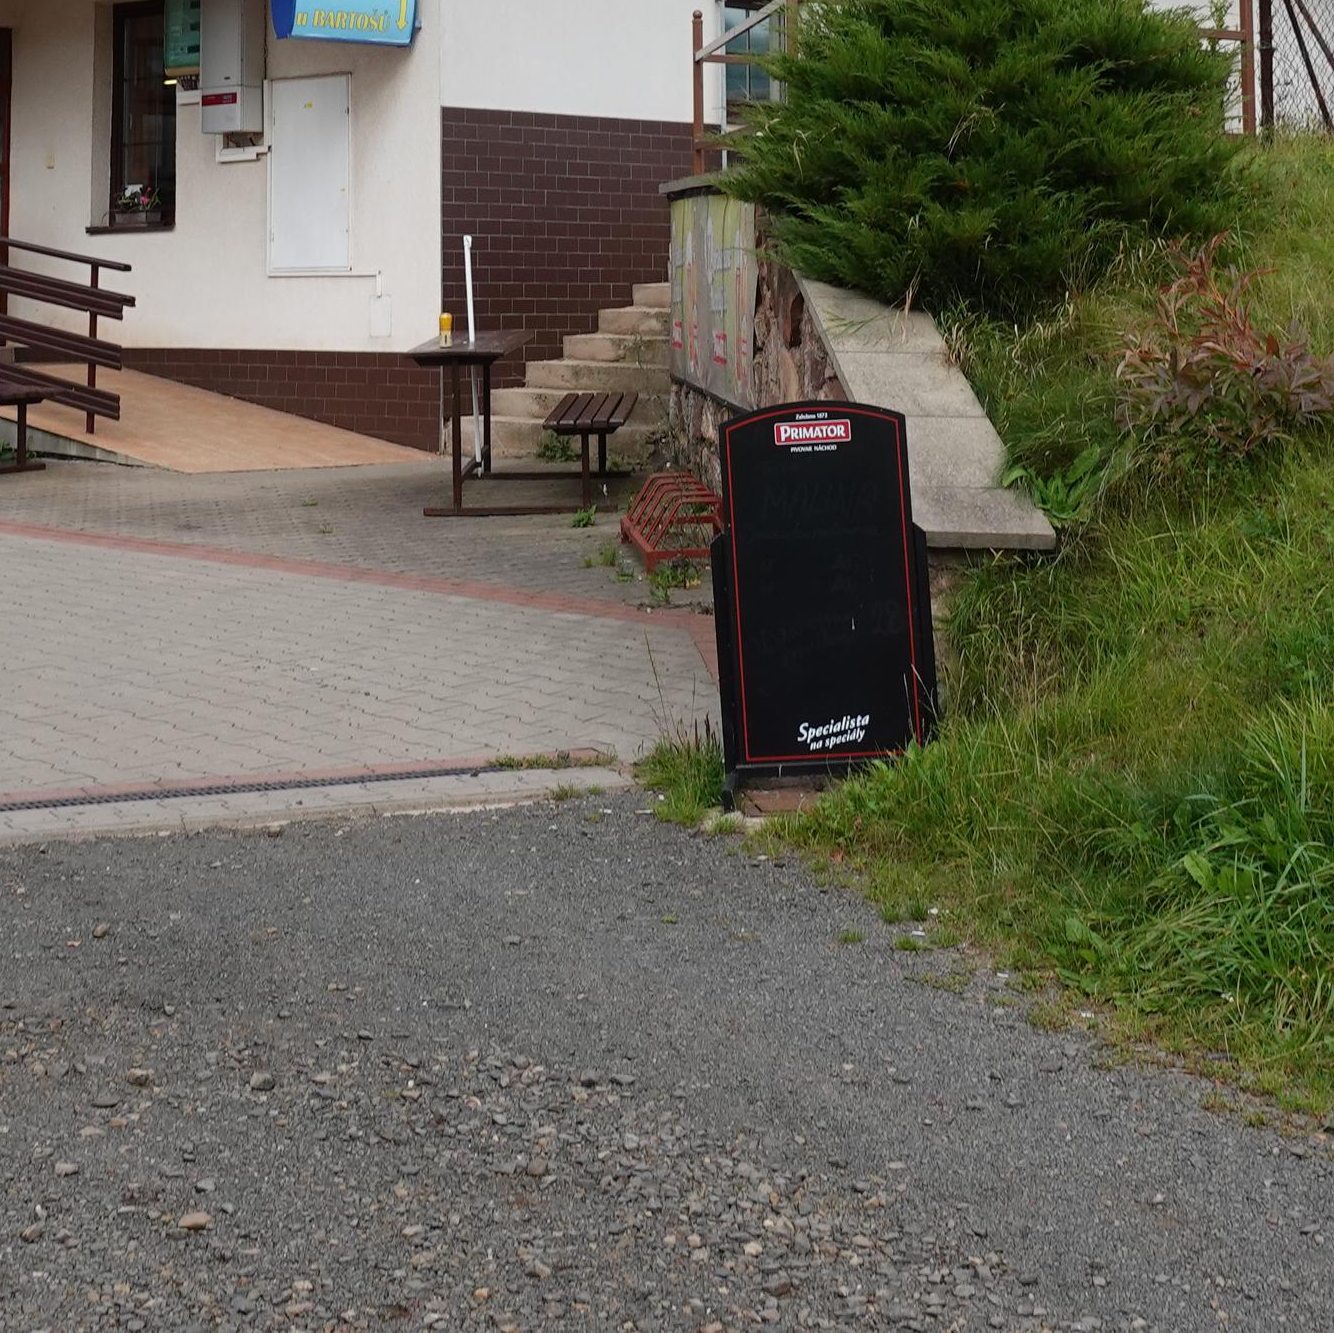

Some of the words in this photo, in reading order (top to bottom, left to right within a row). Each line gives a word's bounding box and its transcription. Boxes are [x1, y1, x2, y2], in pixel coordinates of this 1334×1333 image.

[780, 425, 846, 442] PRIMATOR
[797, 714, 870, 744] Specialista
[810, 740, 823, 751] na
